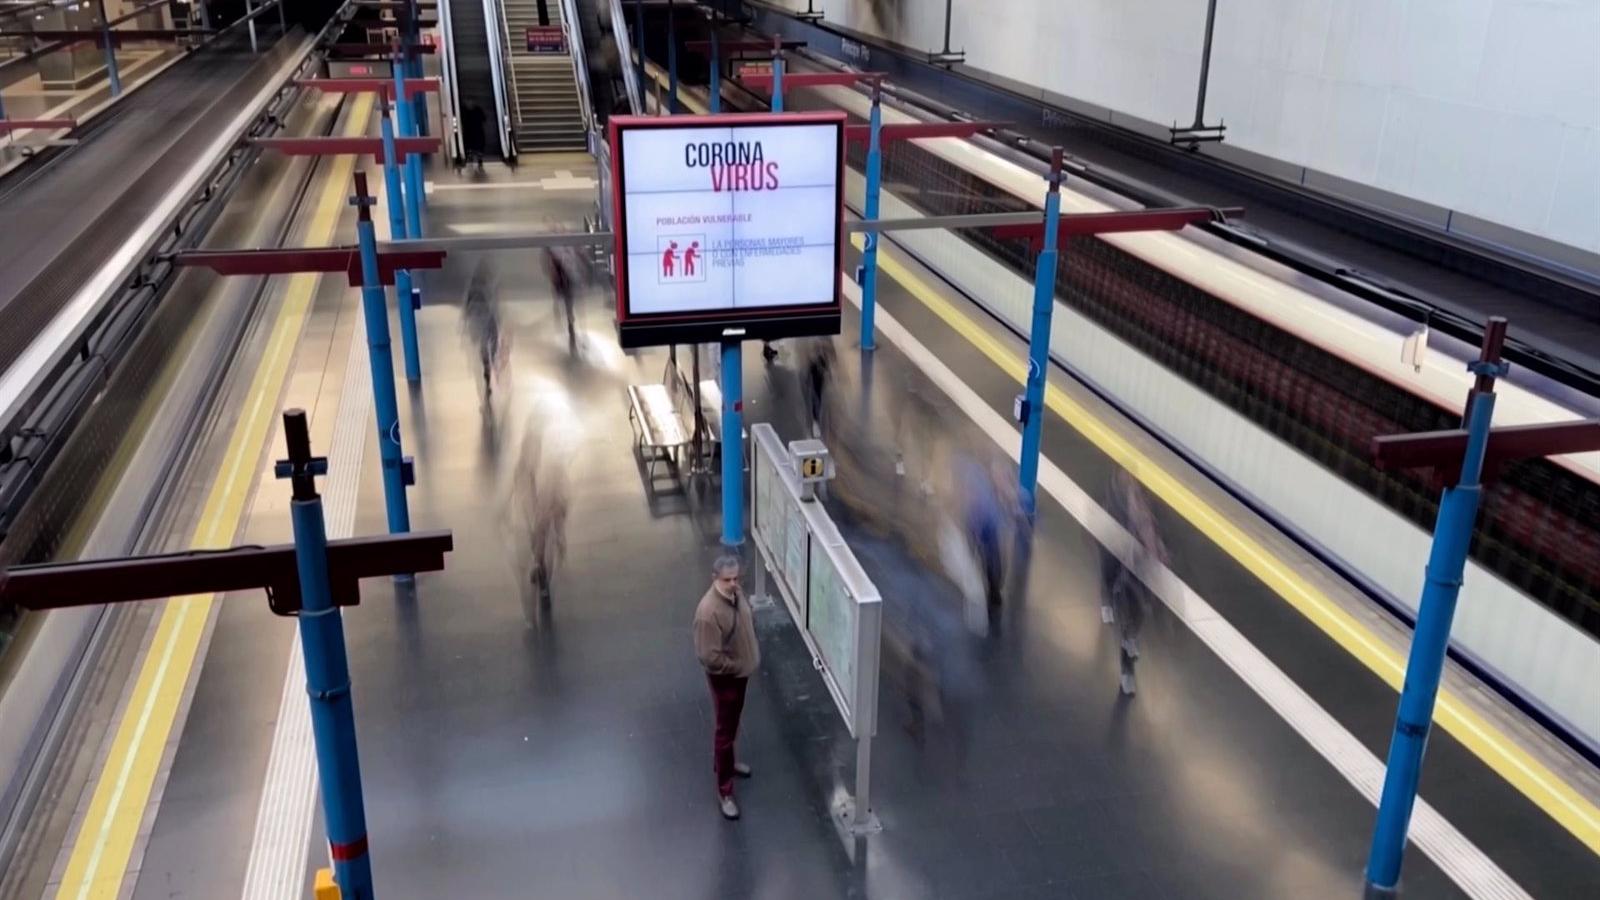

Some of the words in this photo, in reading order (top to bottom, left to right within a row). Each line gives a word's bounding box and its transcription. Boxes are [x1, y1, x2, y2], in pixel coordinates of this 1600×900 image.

[685, 141, 764, 168] CORONA
[710, 161, 780, 193] VIRUS
[703, 213, 753, 225] VULNERABLE
[724, 239, 766, 249] PERSONAS
[767, 236, 805, 247] MAYORES
[739, 246, 802, 257] ENFERMEDADES
[712, 258, 745, 267] PREVIAS
